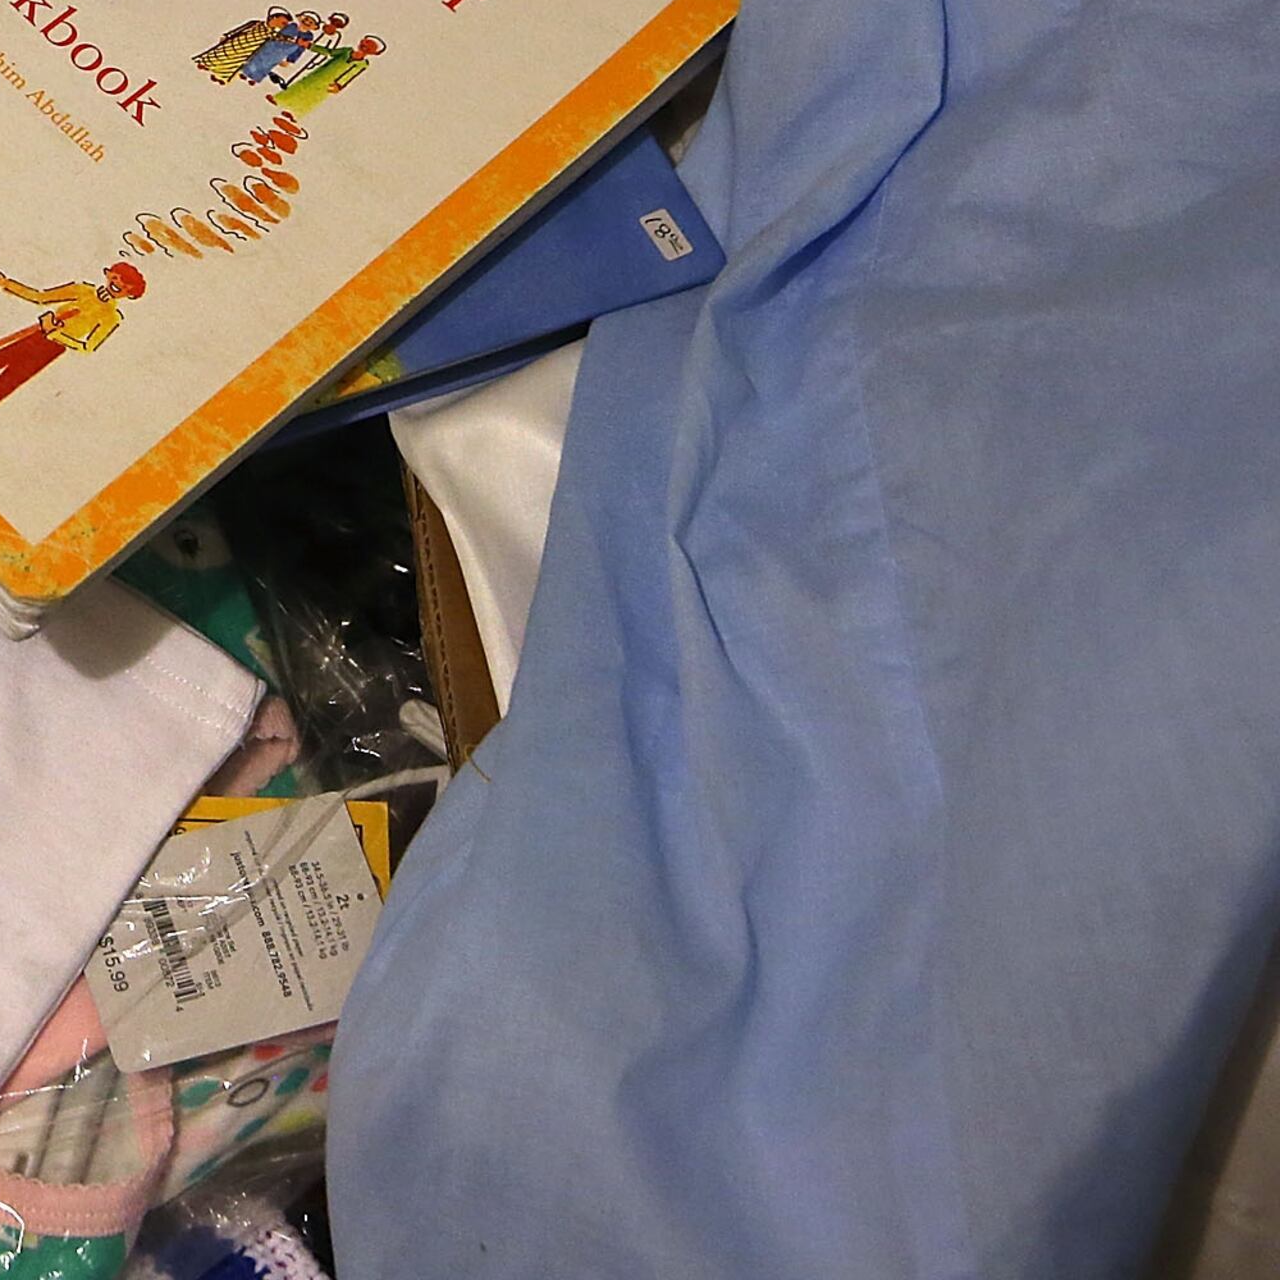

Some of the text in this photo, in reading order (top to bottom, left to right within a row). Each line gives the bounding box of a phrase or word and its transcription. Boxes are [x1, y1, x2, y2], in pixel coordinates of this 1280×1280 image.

[25, 88, 106, 165] Abdallah
[336, 893, 351, 911] 2t
[99, 935, 129, 993] $15.99
[260, 930, 293, 998] 888.782.9548
